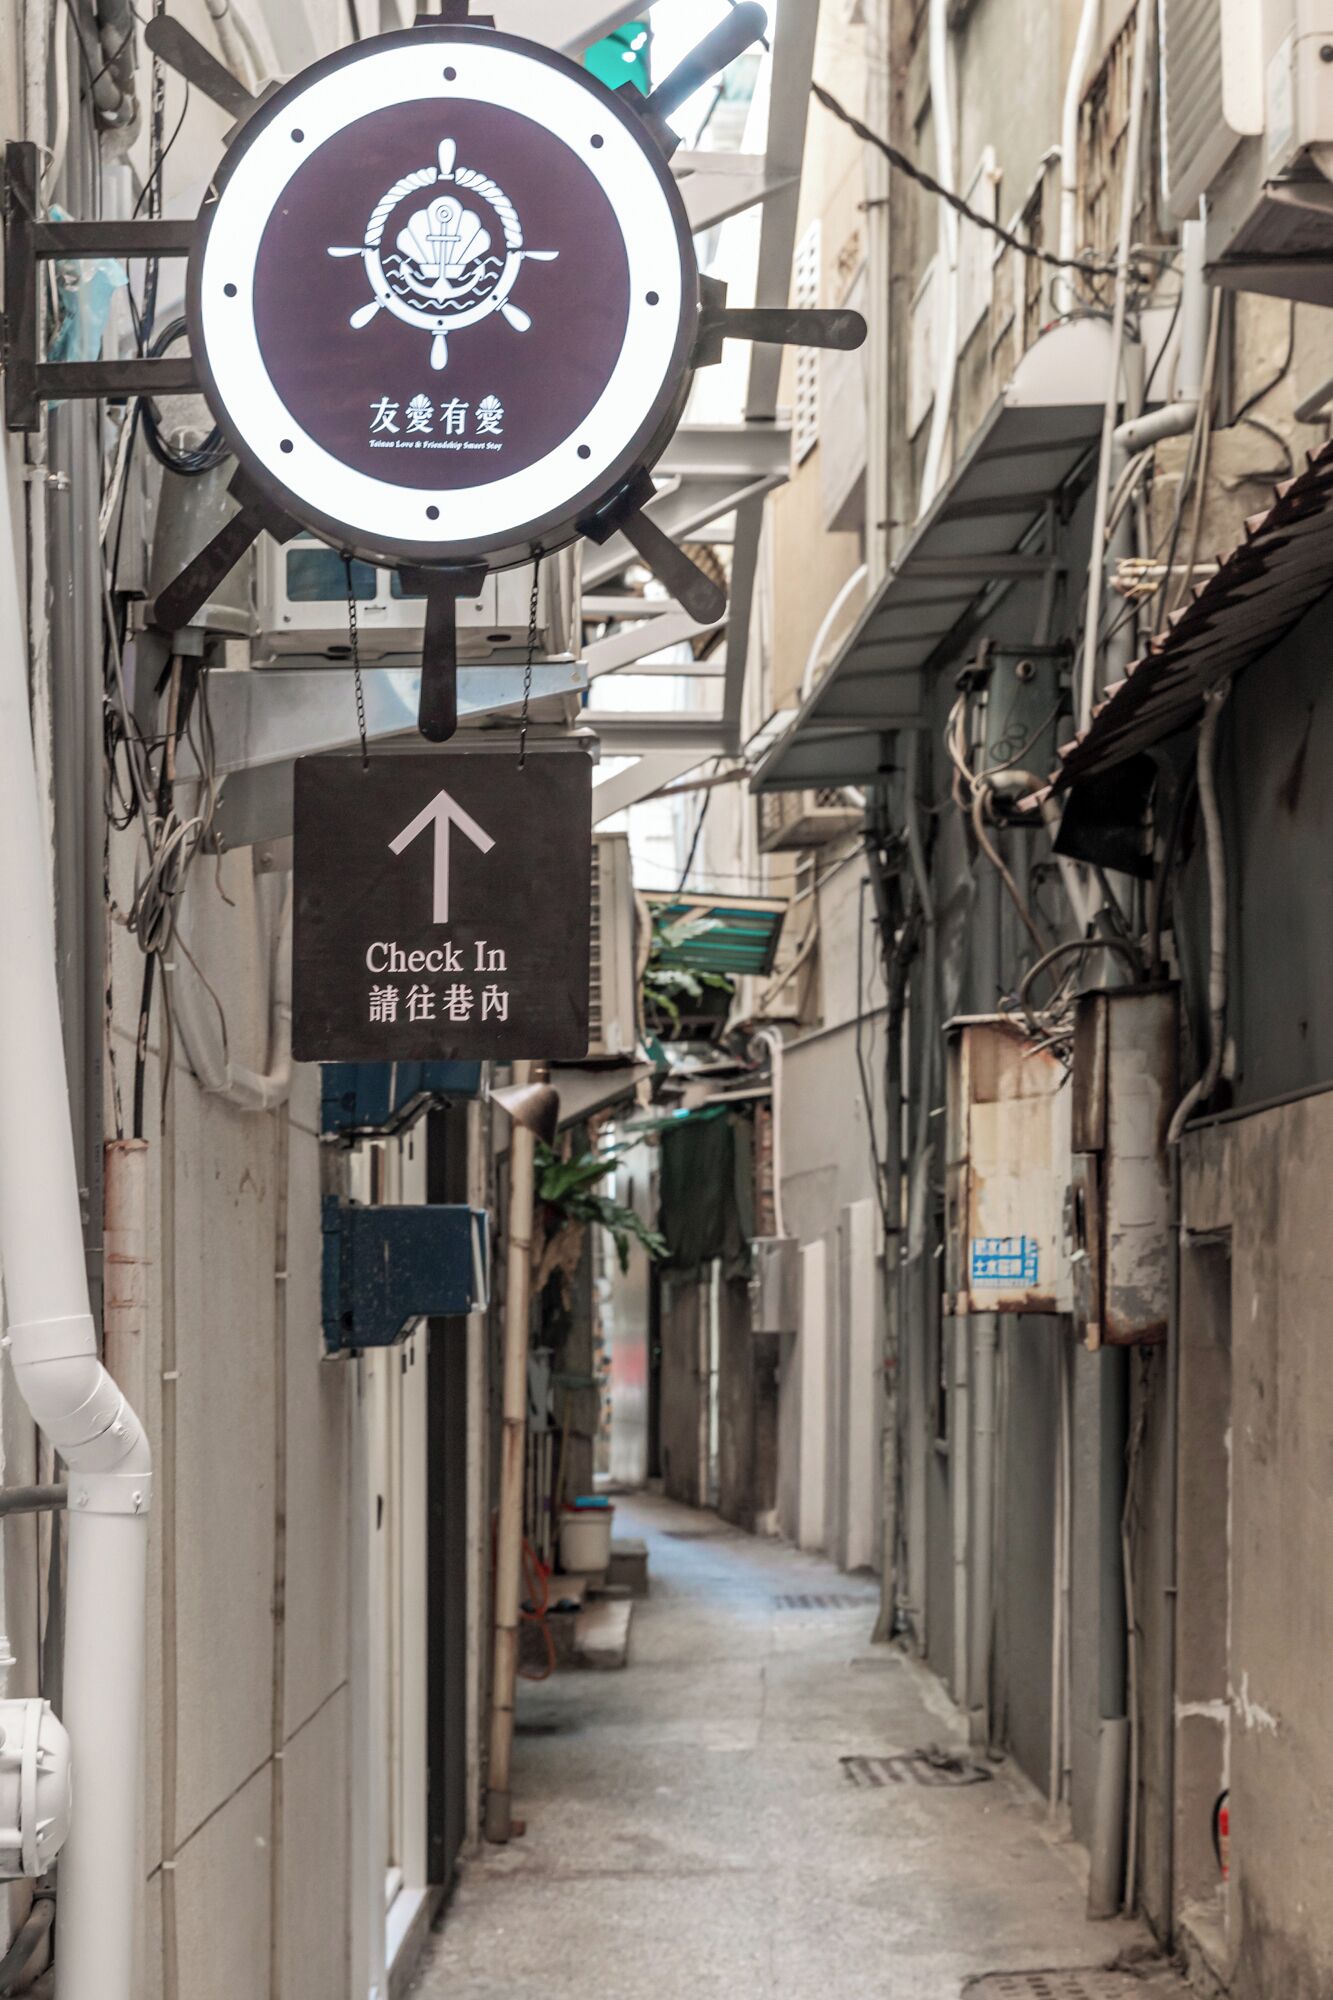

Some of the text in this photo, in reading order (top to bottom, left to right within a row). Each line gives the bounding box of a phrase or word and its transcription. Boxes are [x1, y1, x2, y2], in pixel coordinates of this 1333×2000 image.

[369, 393, 505, 435] 友愛有愛
[395, 440, 414, 448] Love
[422, 440, 462, 451] Friendship
[463, 441, 485, 450] Smart
[486, 441, 503, 451] Stay
[365, 940, 507, 973] Check In
[368, 983, 509, 1023] 請往巷內
